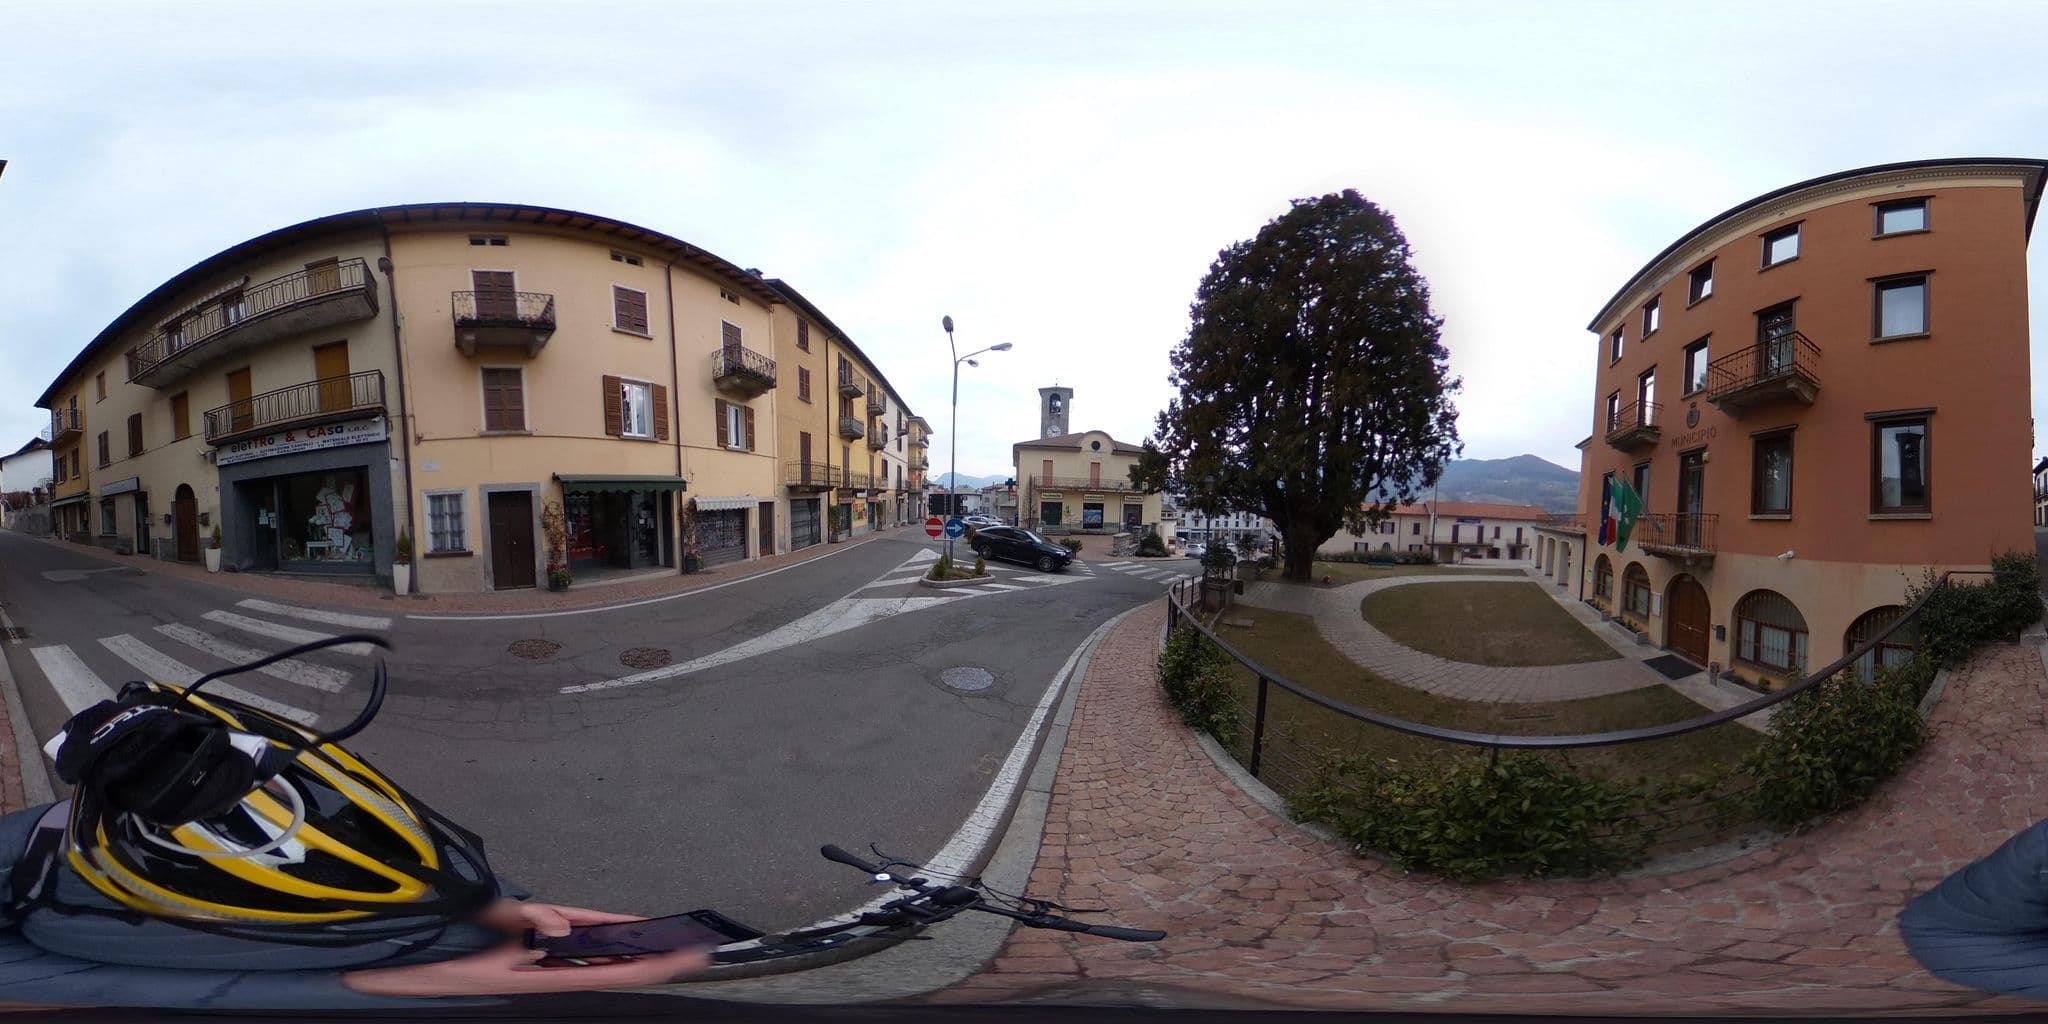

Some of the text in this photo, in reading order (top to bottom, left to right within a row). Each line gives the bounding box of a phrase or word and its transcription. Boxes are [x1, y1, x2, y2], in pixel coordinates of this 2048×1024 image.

[231, 437, 275, 453] eletTRo
[286, 431, 296, 443] &
[306, 425, 344, 439] CAsa
[1671, 427, 1717, 449] MUNICIPIO
